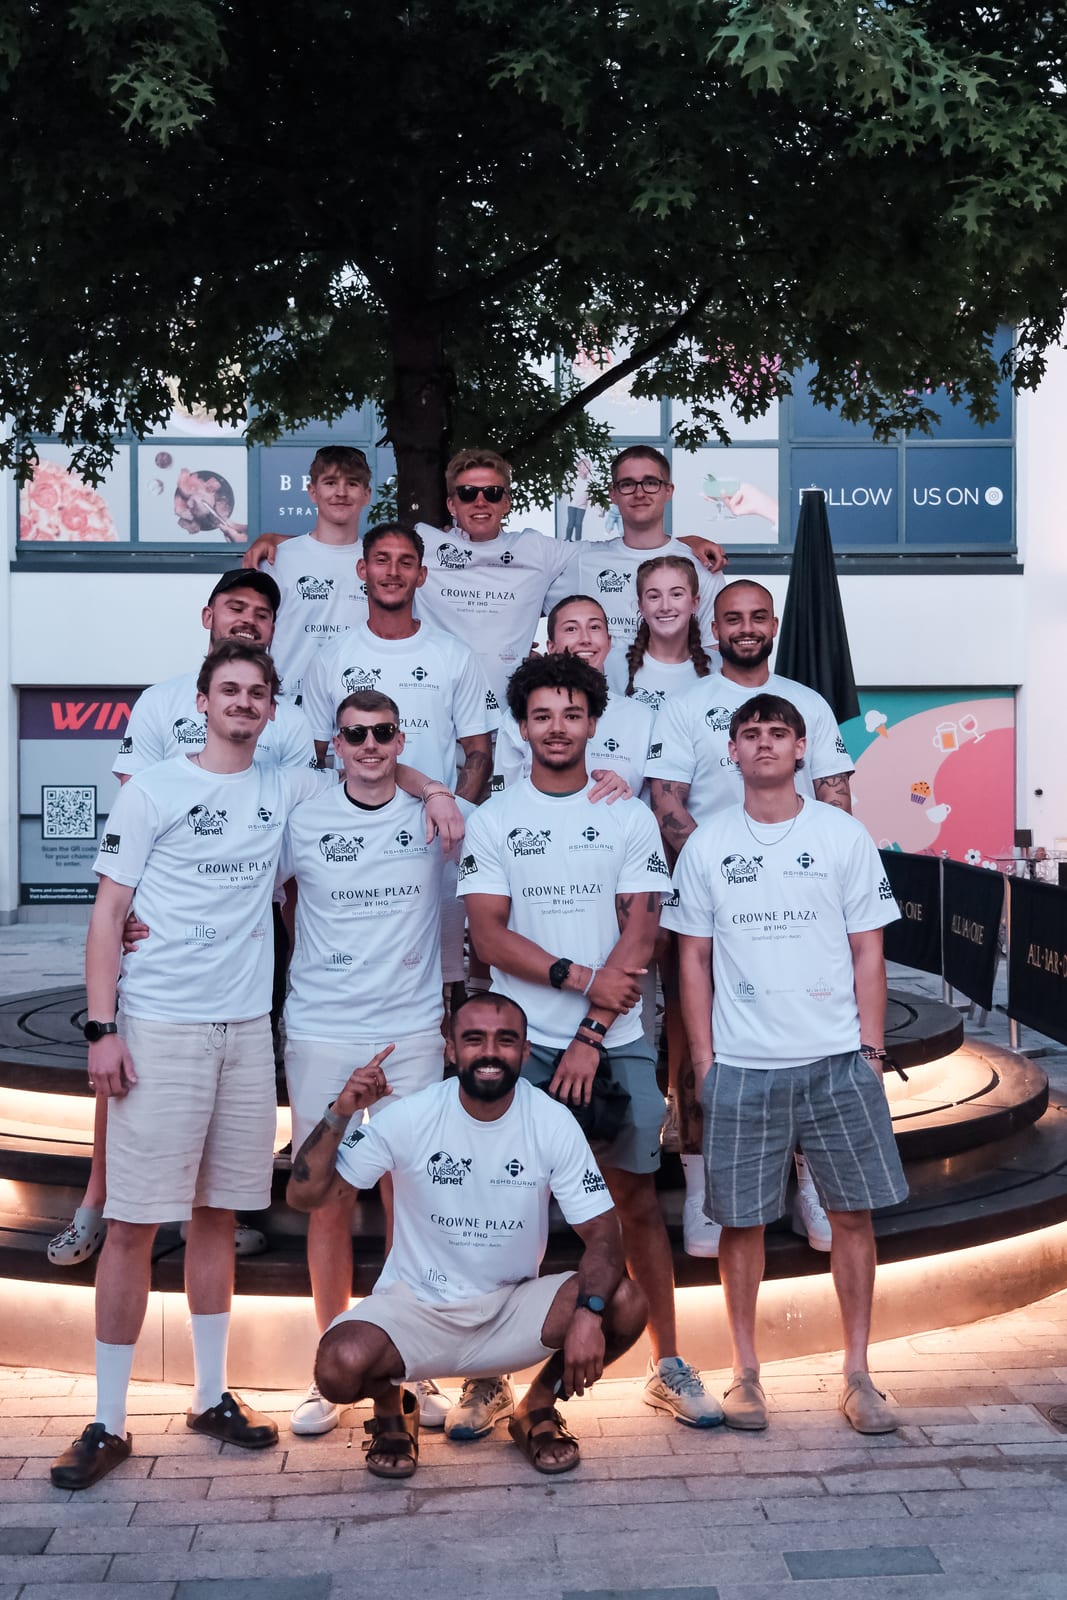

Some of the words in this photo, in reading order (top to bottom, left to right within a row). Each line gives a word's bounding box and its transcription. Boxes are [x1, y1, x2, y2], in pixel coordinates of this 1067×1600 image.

[799, 488, 892, 506] FLLOW
[913, 488, 941, 506] US
[946, 488, 978, 506] ON
[279, 507, 318, 516] STRAT
[441, 553, 467, 562] Mission
[440, 560, 465, 569] Planet
[441, 589, 480, 598] CROWNE
[486, 591, 515, 600] PLAZA
[346, 676, 376, 685] Mission
[347, 684, 374, 693] Planet
[399, 719, 429, 728] PLAZA
[194, 818, 223, 827] Mission
[194, 826, 223, 835] Planet
[513, 840, 546, 848] Mission
[325, 846, 358, 854] Mission
[514, 847, 545, 857] Planet
[326, 853, 357, 862] Planet
[198, 862, 244, 873] CROWNE
[726, 867, 758, 876] Mission
[728, 874, 757, 885] Planet
[331, 889, 379, 900] CROWNE
[385, 886, 420, 896] PLAZA
[522, 885, 566, 897] CROWNE
[570, 884, 601, 894] PLAZA
[732, 912, 778, 924] CROWNE
[784, 911, 817, 920] PLAZA
[1027, 944, 1041, 968] ALL
[432, 1175, 463, 1185] Planet
[431, 1214, 480, 1228] CROWNE
[486, 1220, 523, 1230] PLAZA
